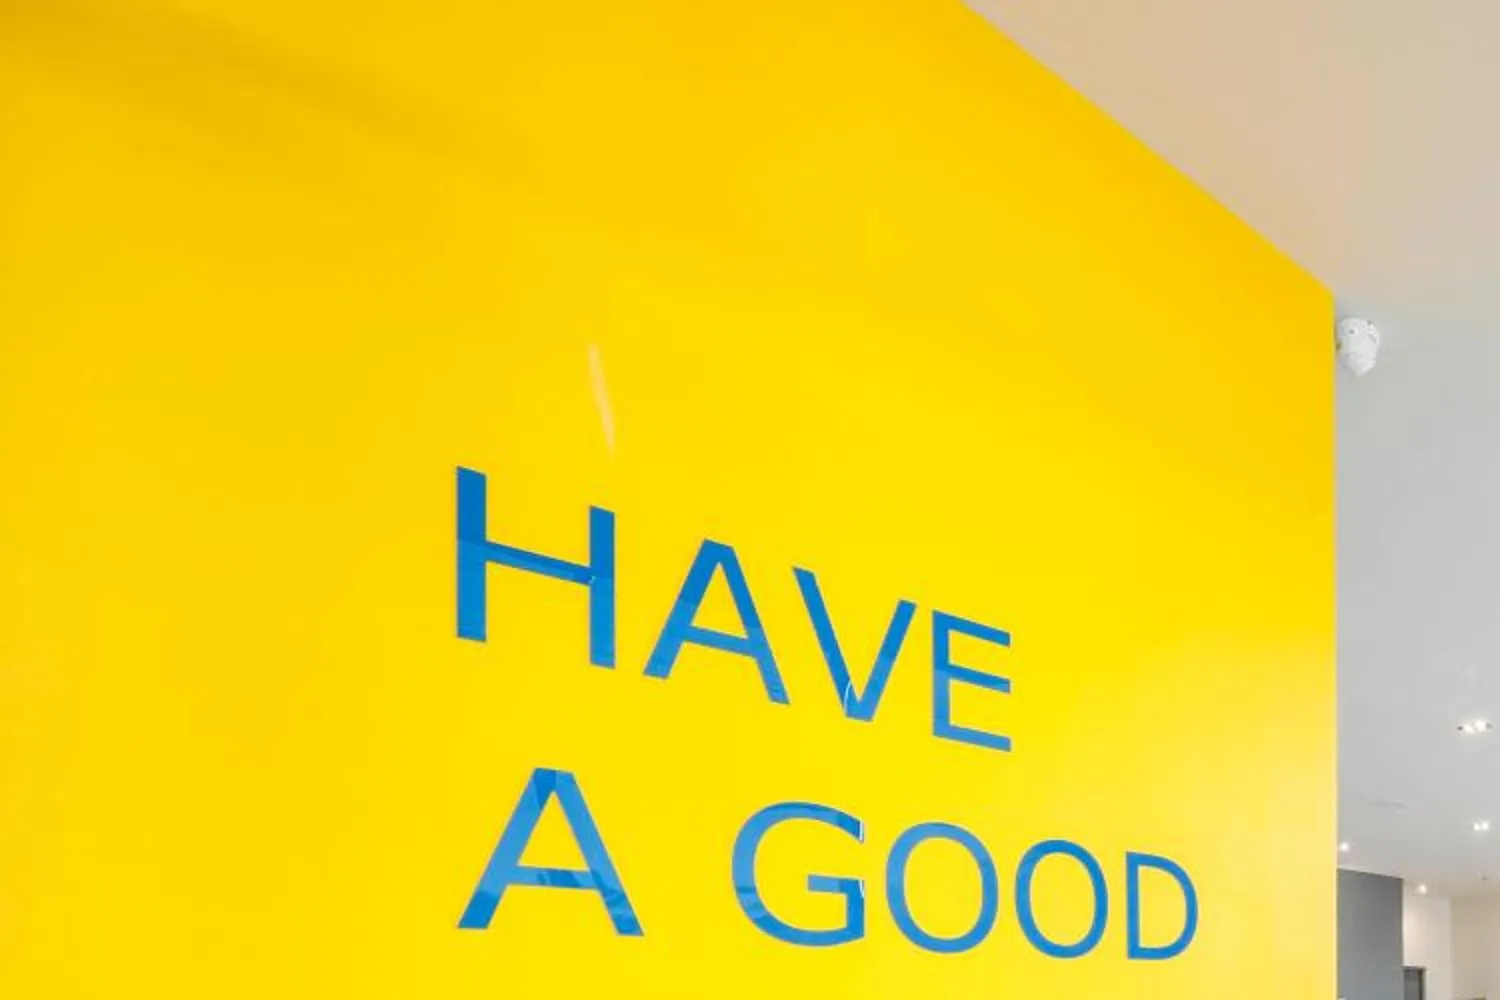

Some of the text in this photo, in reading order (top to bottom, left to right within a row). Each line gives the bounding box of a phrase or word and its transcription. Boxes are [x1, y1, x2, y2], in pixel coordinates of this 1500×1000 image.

[456, 466, 1012, 752] HAVE
[457, 767, 1198, 961] A GOOD
